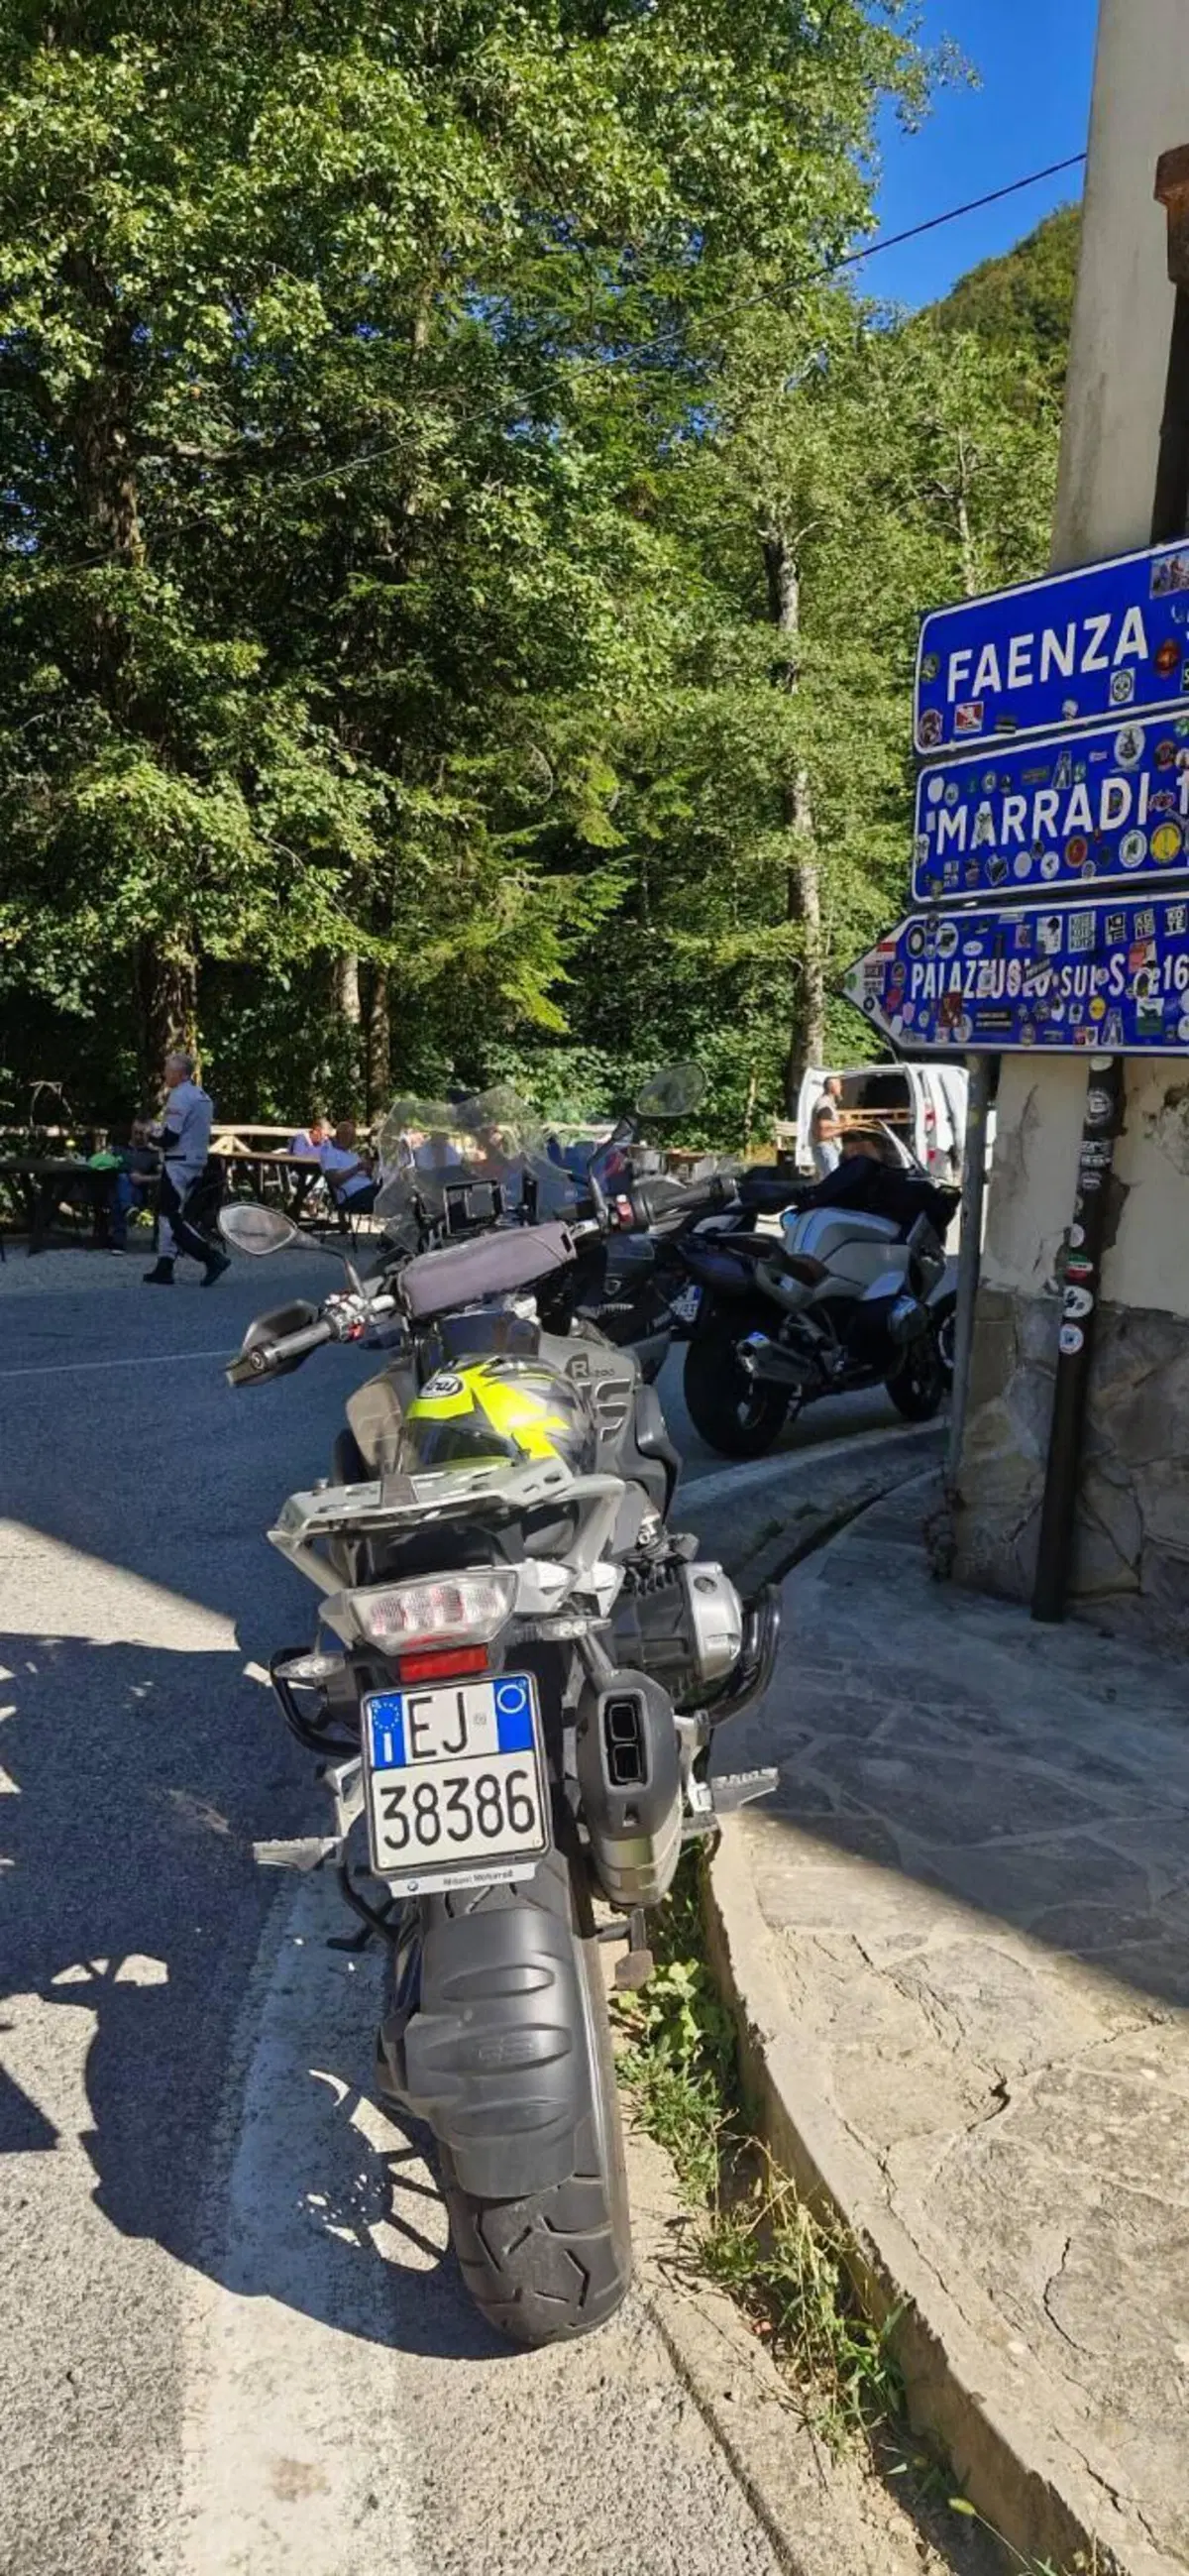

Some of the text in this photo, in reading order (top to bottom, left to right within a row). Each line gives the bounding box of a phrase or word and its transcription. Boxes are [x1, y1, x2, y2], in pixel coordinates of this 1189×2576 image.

[947, 606, 1149, 703] FAENZA
[936, 772, 1150, 855] MARRADI
[1060, 964, 1099, 997] SUL
[383, 1732, 393, 1763] I
[406, 1691, 469, 1759] EJ
[379, 1769, 536, 1850] 38386
